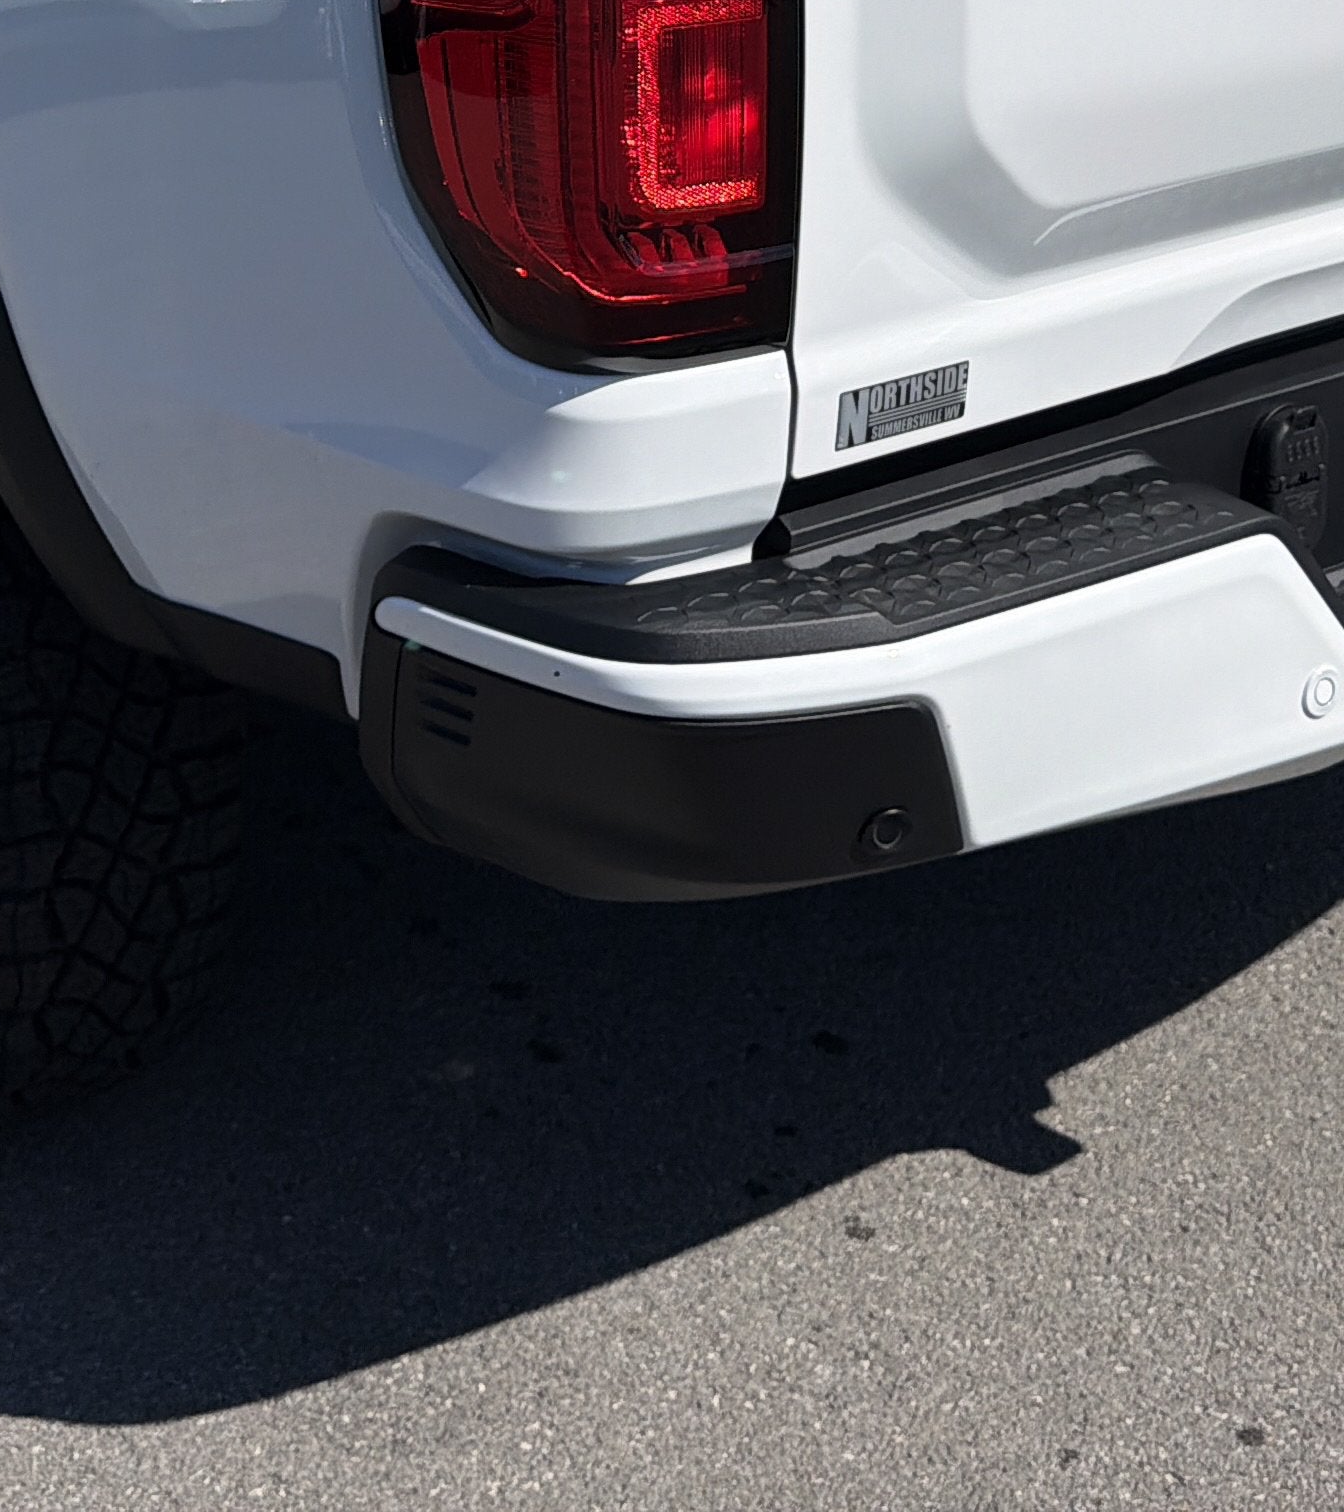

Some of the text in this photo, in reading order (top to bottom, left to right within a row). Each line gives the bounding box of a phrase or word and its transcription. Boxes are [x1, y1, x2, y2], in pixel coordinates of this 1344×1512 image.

[837, 363, 968, 449] NORTHSIDE
[871, 403, 962, 441] SUMMERSVILLE WV
